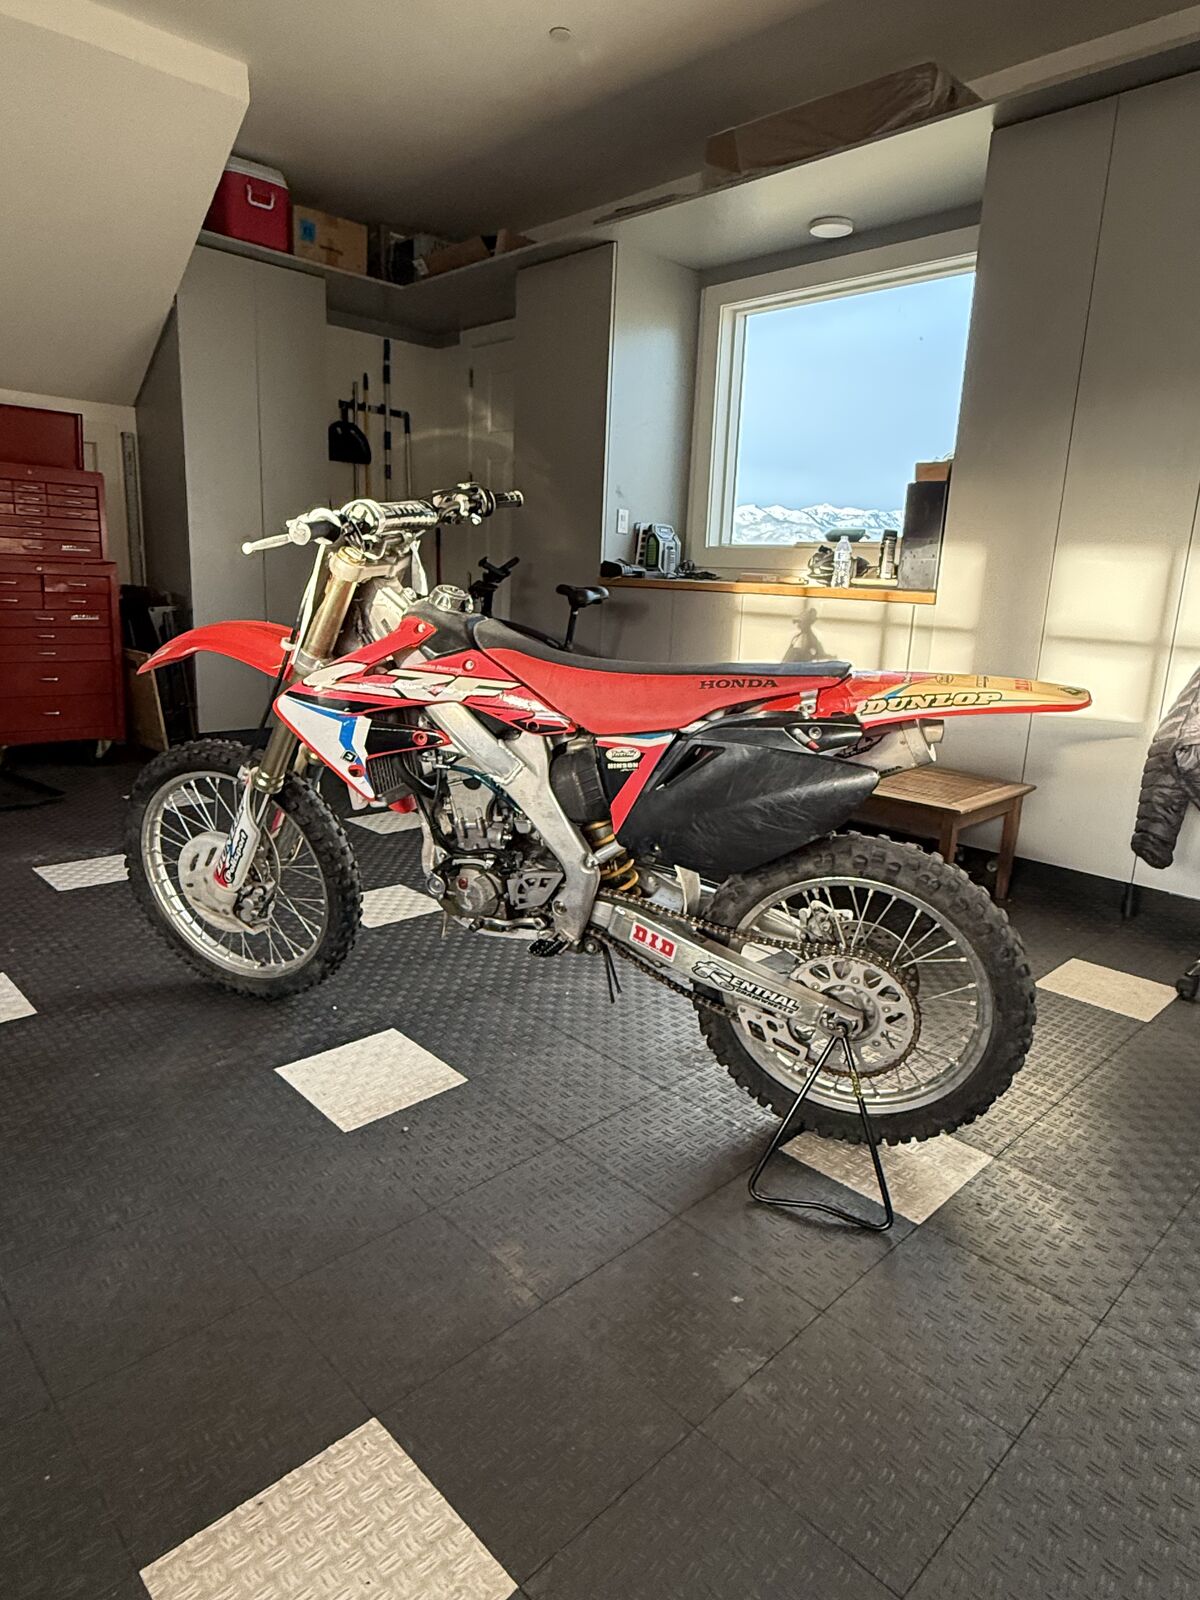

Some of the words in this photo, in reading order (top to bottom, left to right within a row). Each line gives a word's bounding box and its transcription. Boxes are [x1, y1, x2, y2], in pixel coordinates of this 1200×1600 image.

[699, 679, 778, 689] HONDA
[860, 692, 1002, 715] DUNLOP
[223, 828, 248, 884] Polisport
[692, 961, 799, 1011] RENTHAL
